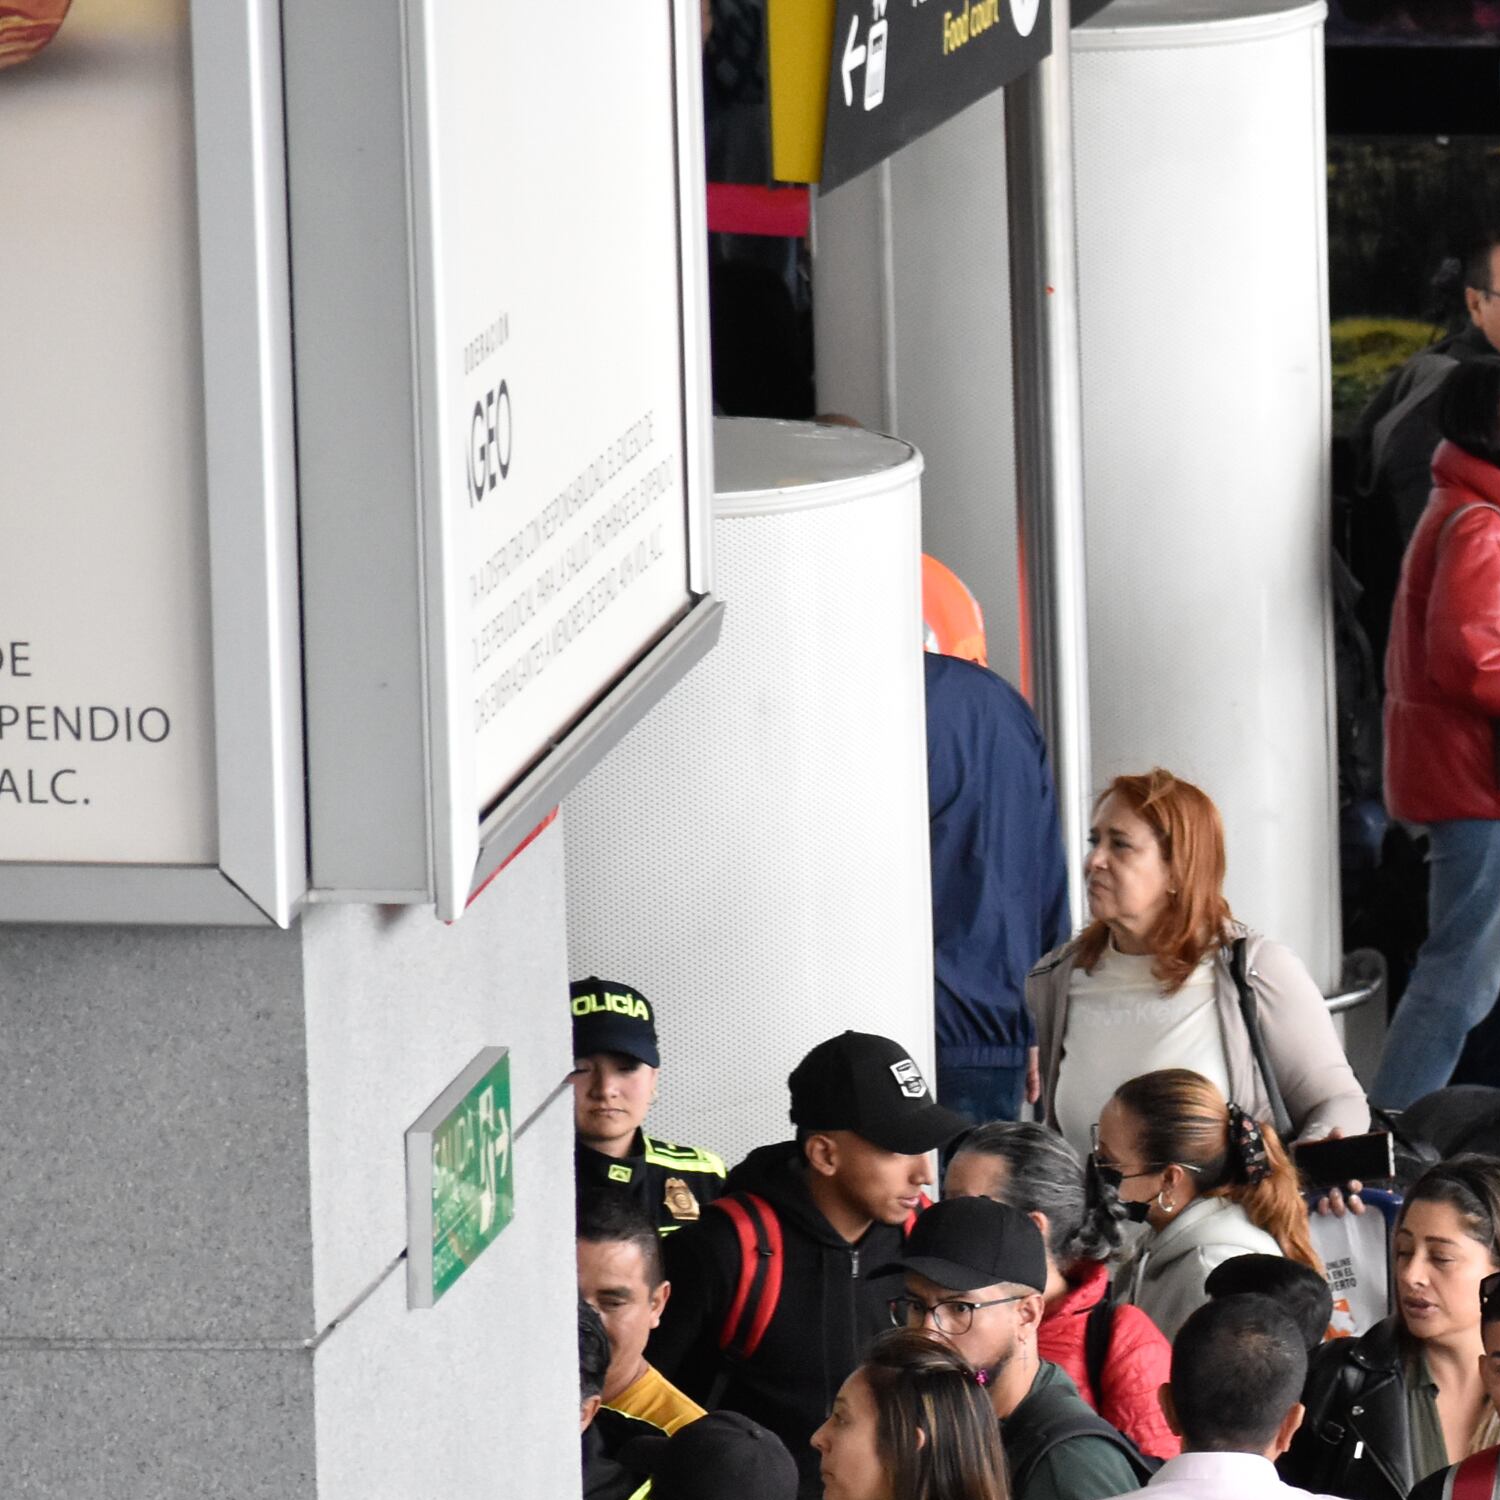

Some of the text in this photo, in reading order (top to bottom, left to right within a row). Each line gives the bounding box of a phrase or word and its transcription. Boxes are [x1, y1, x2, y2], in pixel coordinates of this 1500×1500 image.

[0, 642, 32, 677] E
[0, 769, 90, 805] ALC.
[572, 992, 649, 1021] OLICÍA
